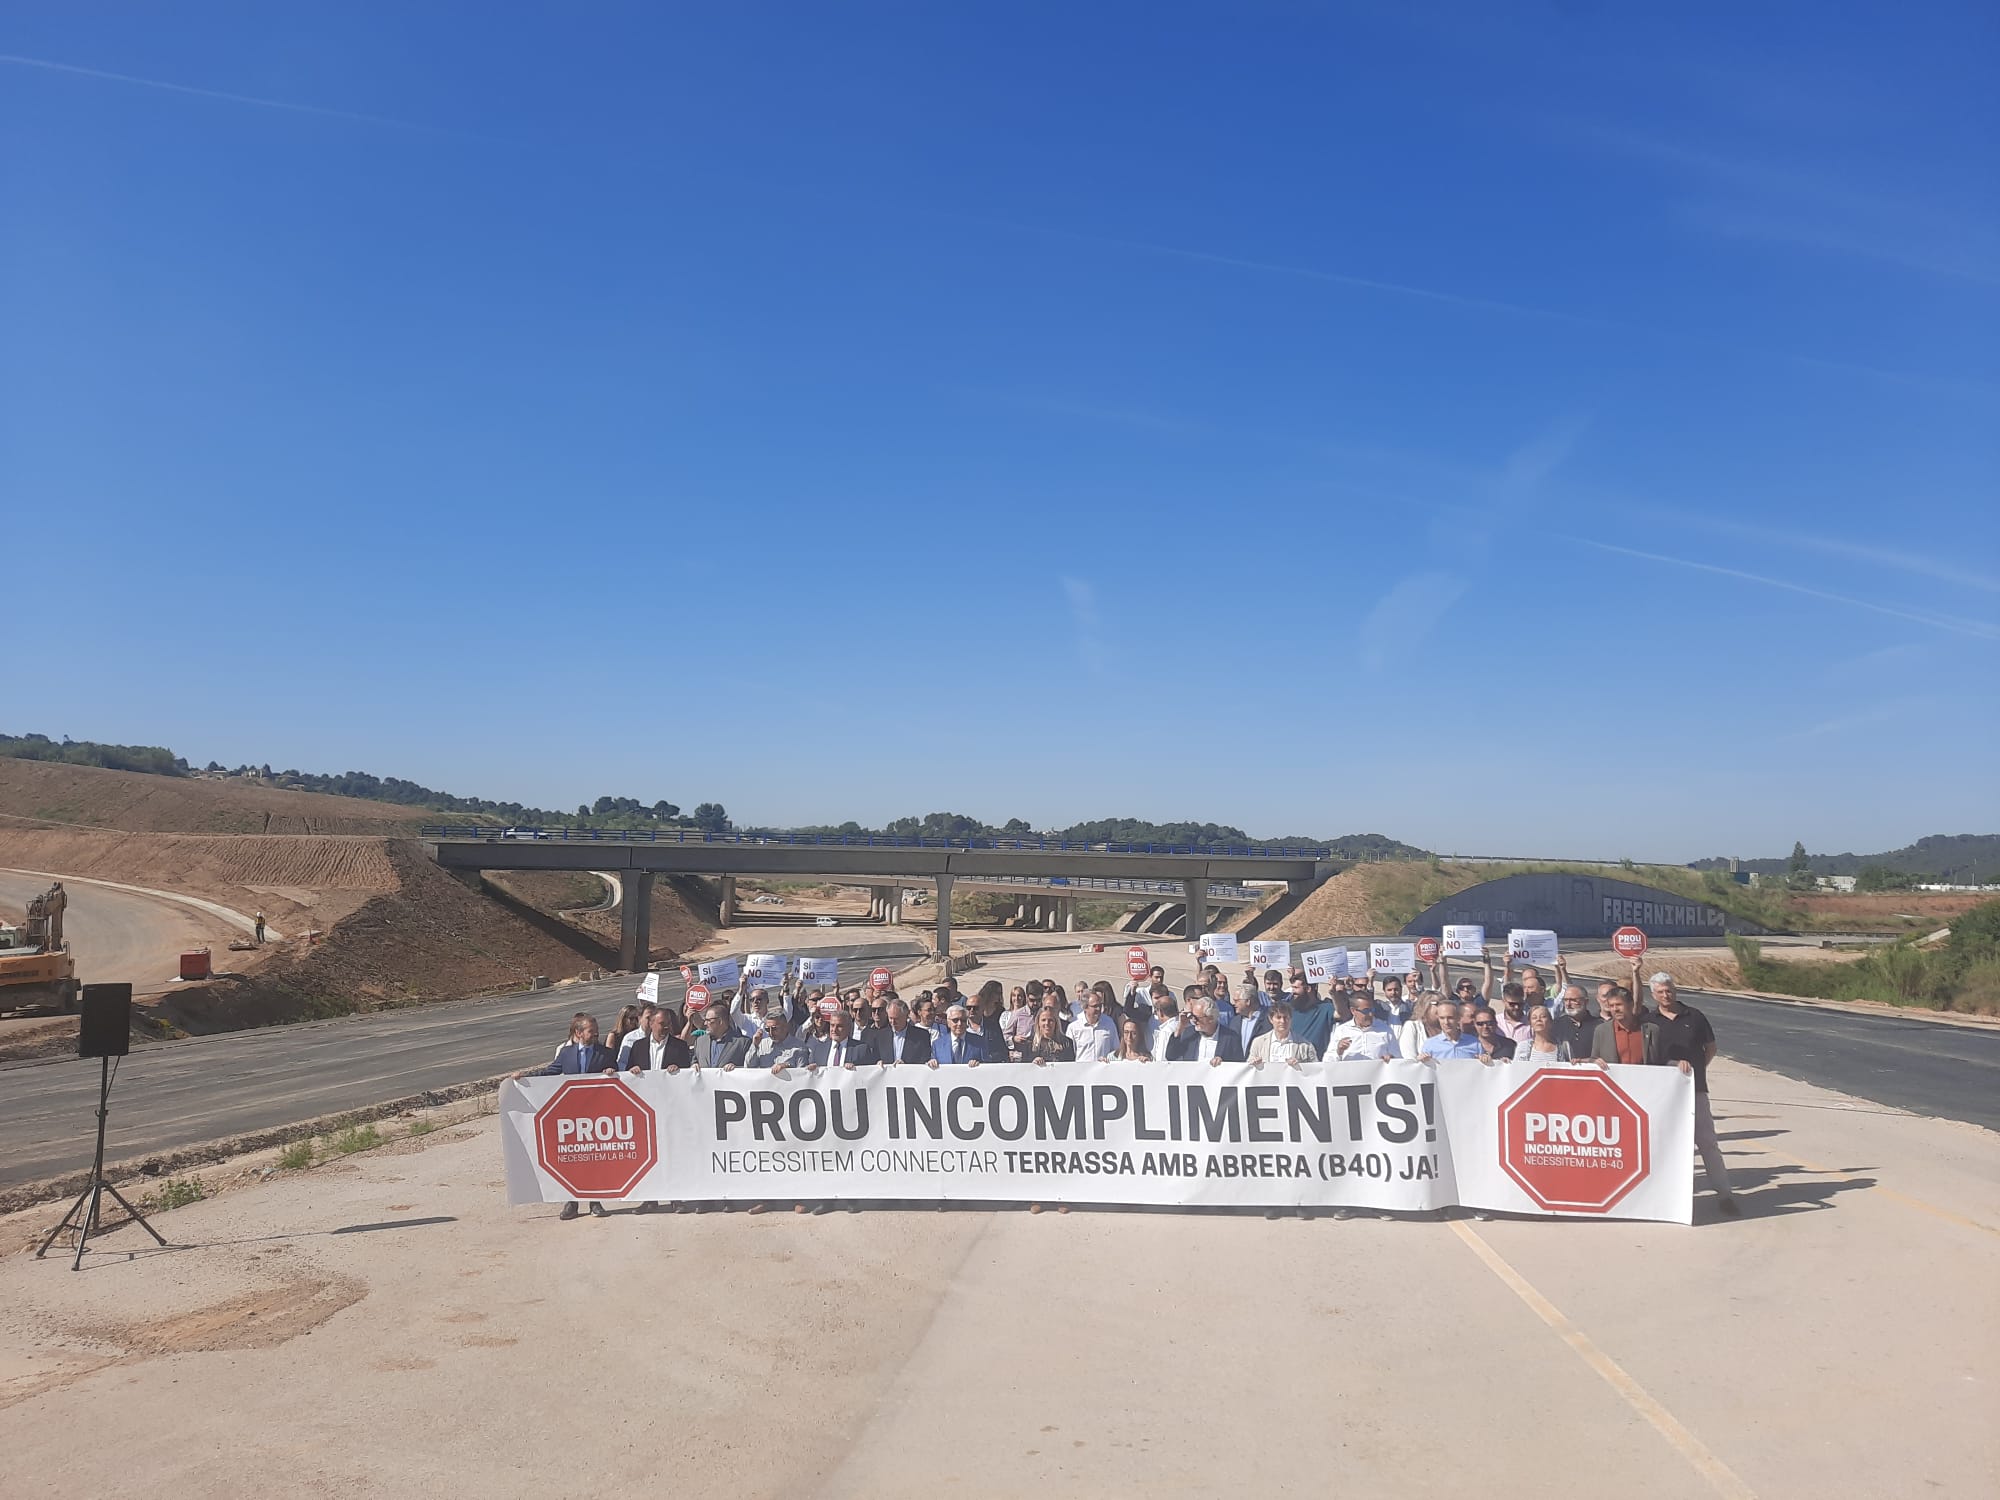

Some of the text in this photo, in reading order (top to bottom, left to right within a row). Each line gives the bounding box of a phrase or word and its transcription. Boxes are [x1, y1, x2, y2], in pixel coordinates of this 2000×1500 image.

[1617, 934, 1641, 942] PROU
[1446, 940, 1461, 950] NO
[1253, 955, 1267, 964] NO
[1513, 950, 1530, 959] NO
[1375, 958, 1390, 968] NO
[747, 969, 762, 979] NO
[1309, 967, 1325, 977] NO
[704, 975, 717, 985] NO
[689, 990, 707, 999] PROU
[714, 1083, 1437, 1143] PROU INCOMPLIMENTS!
[557, 1115, 634, 1142] PROU
[1525, 1112, 1620, 1145] PROU
[558, 1142, 636, 1153] INCOMPLIMENTS
[1525, 1144, 1622, 1157] INCOMPLIMENTS
[558, 1153, 606, 1163] NECESSITEM
[1524, 1156, 1624, 1169] NECESSITEM LA B-40
[712, 1149, 1440, 1183] NECESSITEM CONNECTAR TERRASSA AMB ABRERA (B40) JA!
